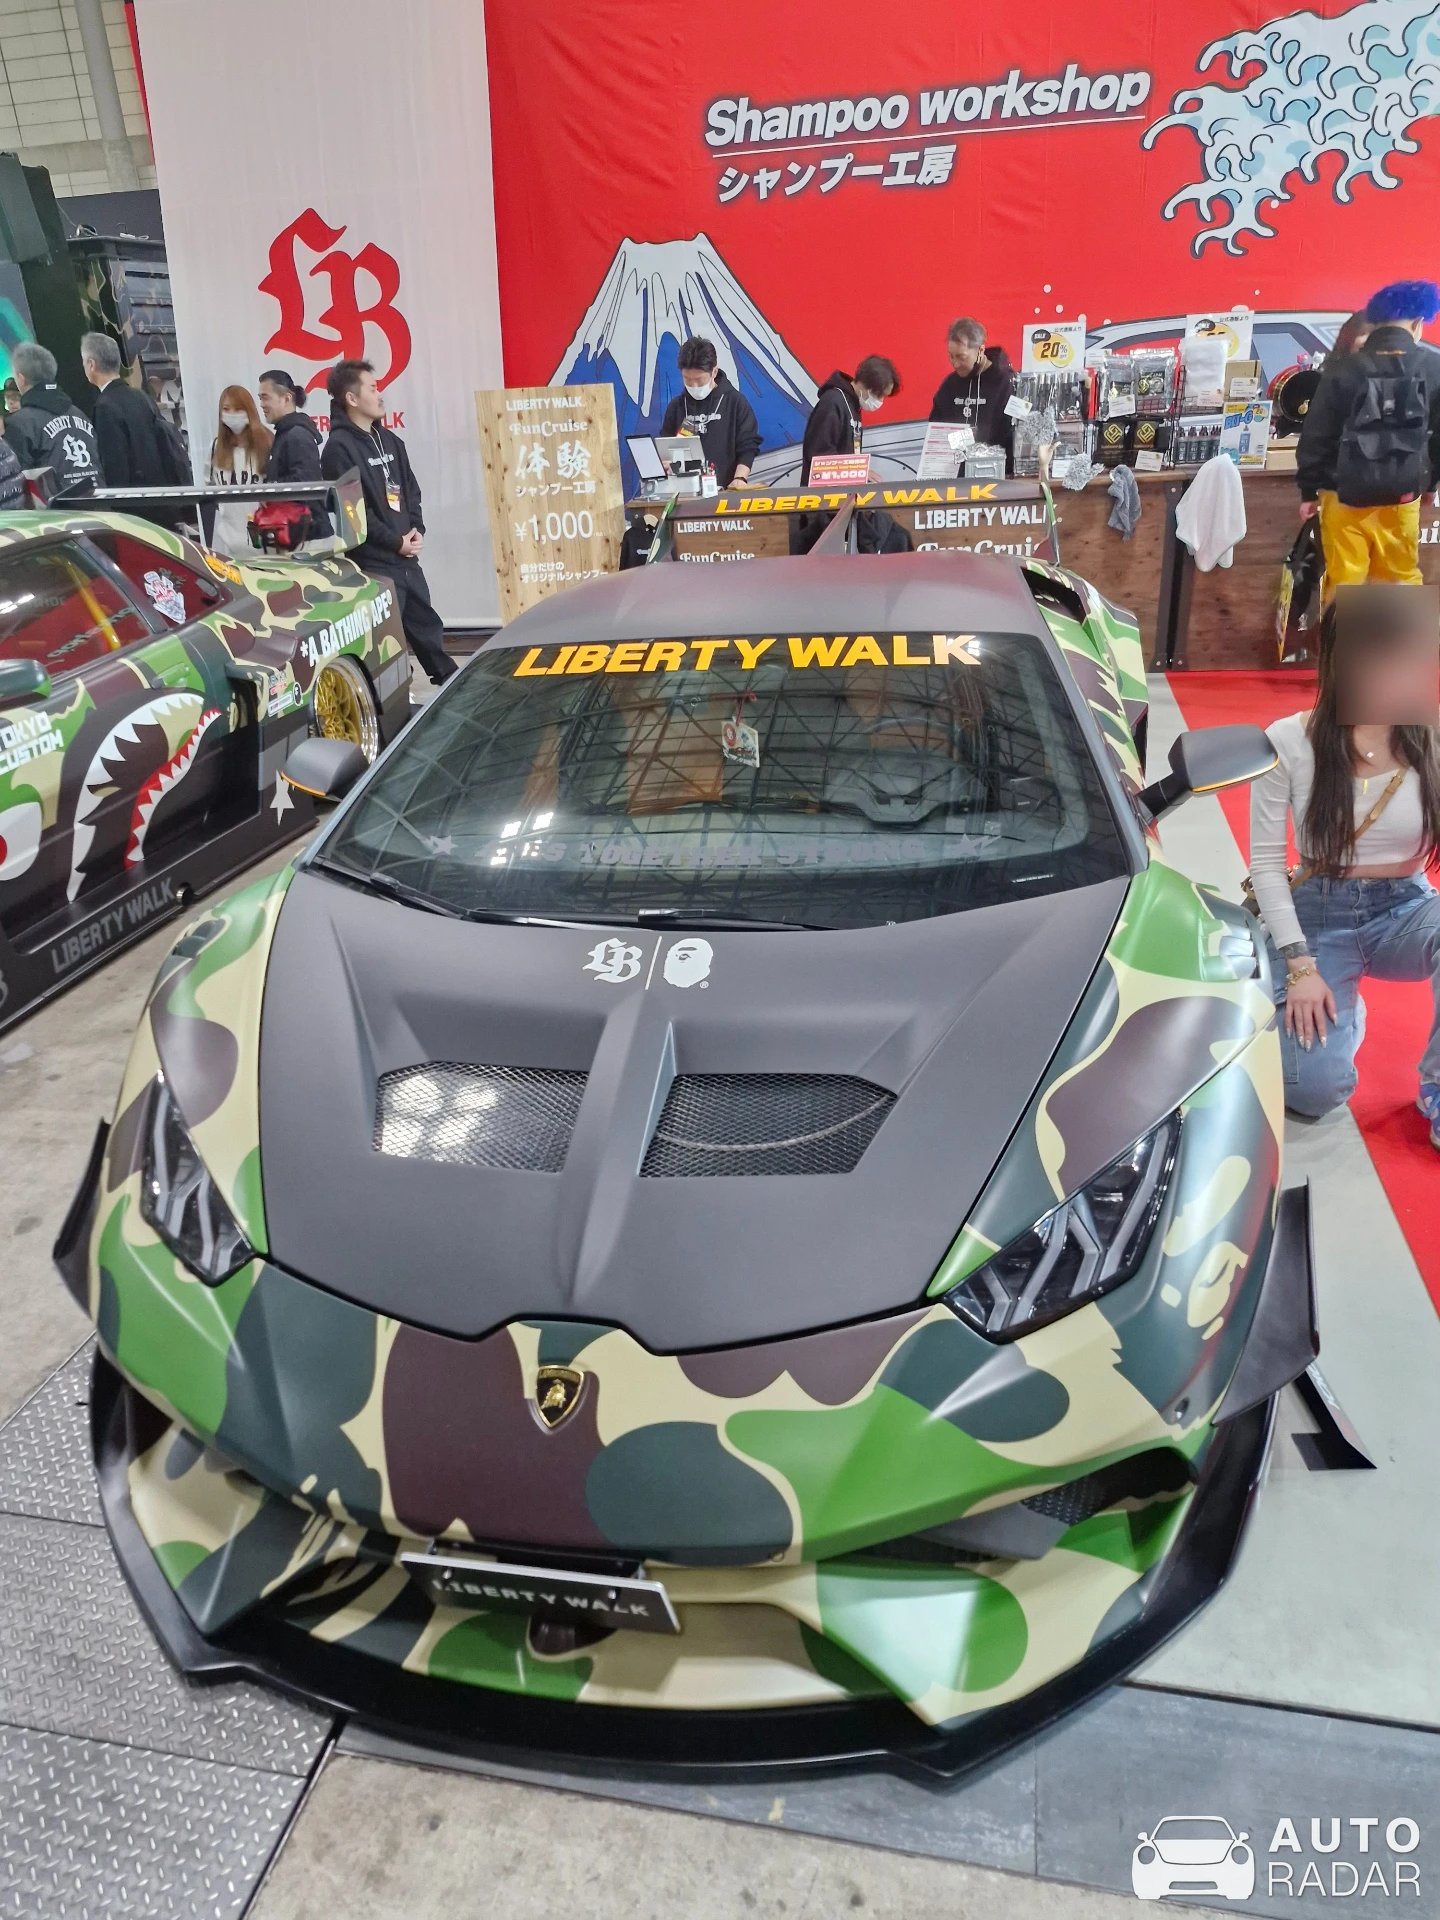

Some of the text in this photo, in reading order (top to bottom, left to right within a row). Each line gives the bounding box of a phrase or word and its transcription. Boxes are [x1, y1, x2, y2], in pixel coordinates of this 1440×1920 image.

[704, 64, 1151, 147] Shampoo workshop
[718, 145, 957, 203] シャンプー工房
[506, 398, 551, 411] LIBERTY
[43, 415, 94, 439] LIBERTY WALK
[509, 419, 588, 437] FunCruise
[516, 481, 596, 497] シャンプー工房
[715, 483, 998, 514] LIBERTY WALK
[514, 510, 594, 544] ¥1,000
[677, 521, 720, 534] LIBERTY
[914, 507, 997, 530] LIBERTY
[520, 562, 564, 573] 自分だけの
[521, 569, 609, 583] オリジナルシャンプー
[319, 606, 371, 658] BATHING
[513, 634, 982, 677] LIBERTY WALK
[0, 711, 52, 749] OKYO
[0, 729, 64, 775] CUSTOM
[580, 843, 763, 866] TOGETHER
[51, 877, 175, 974] LIBERTY WALK
[432, 1579, 649, 1617] LIBERTY WALK
